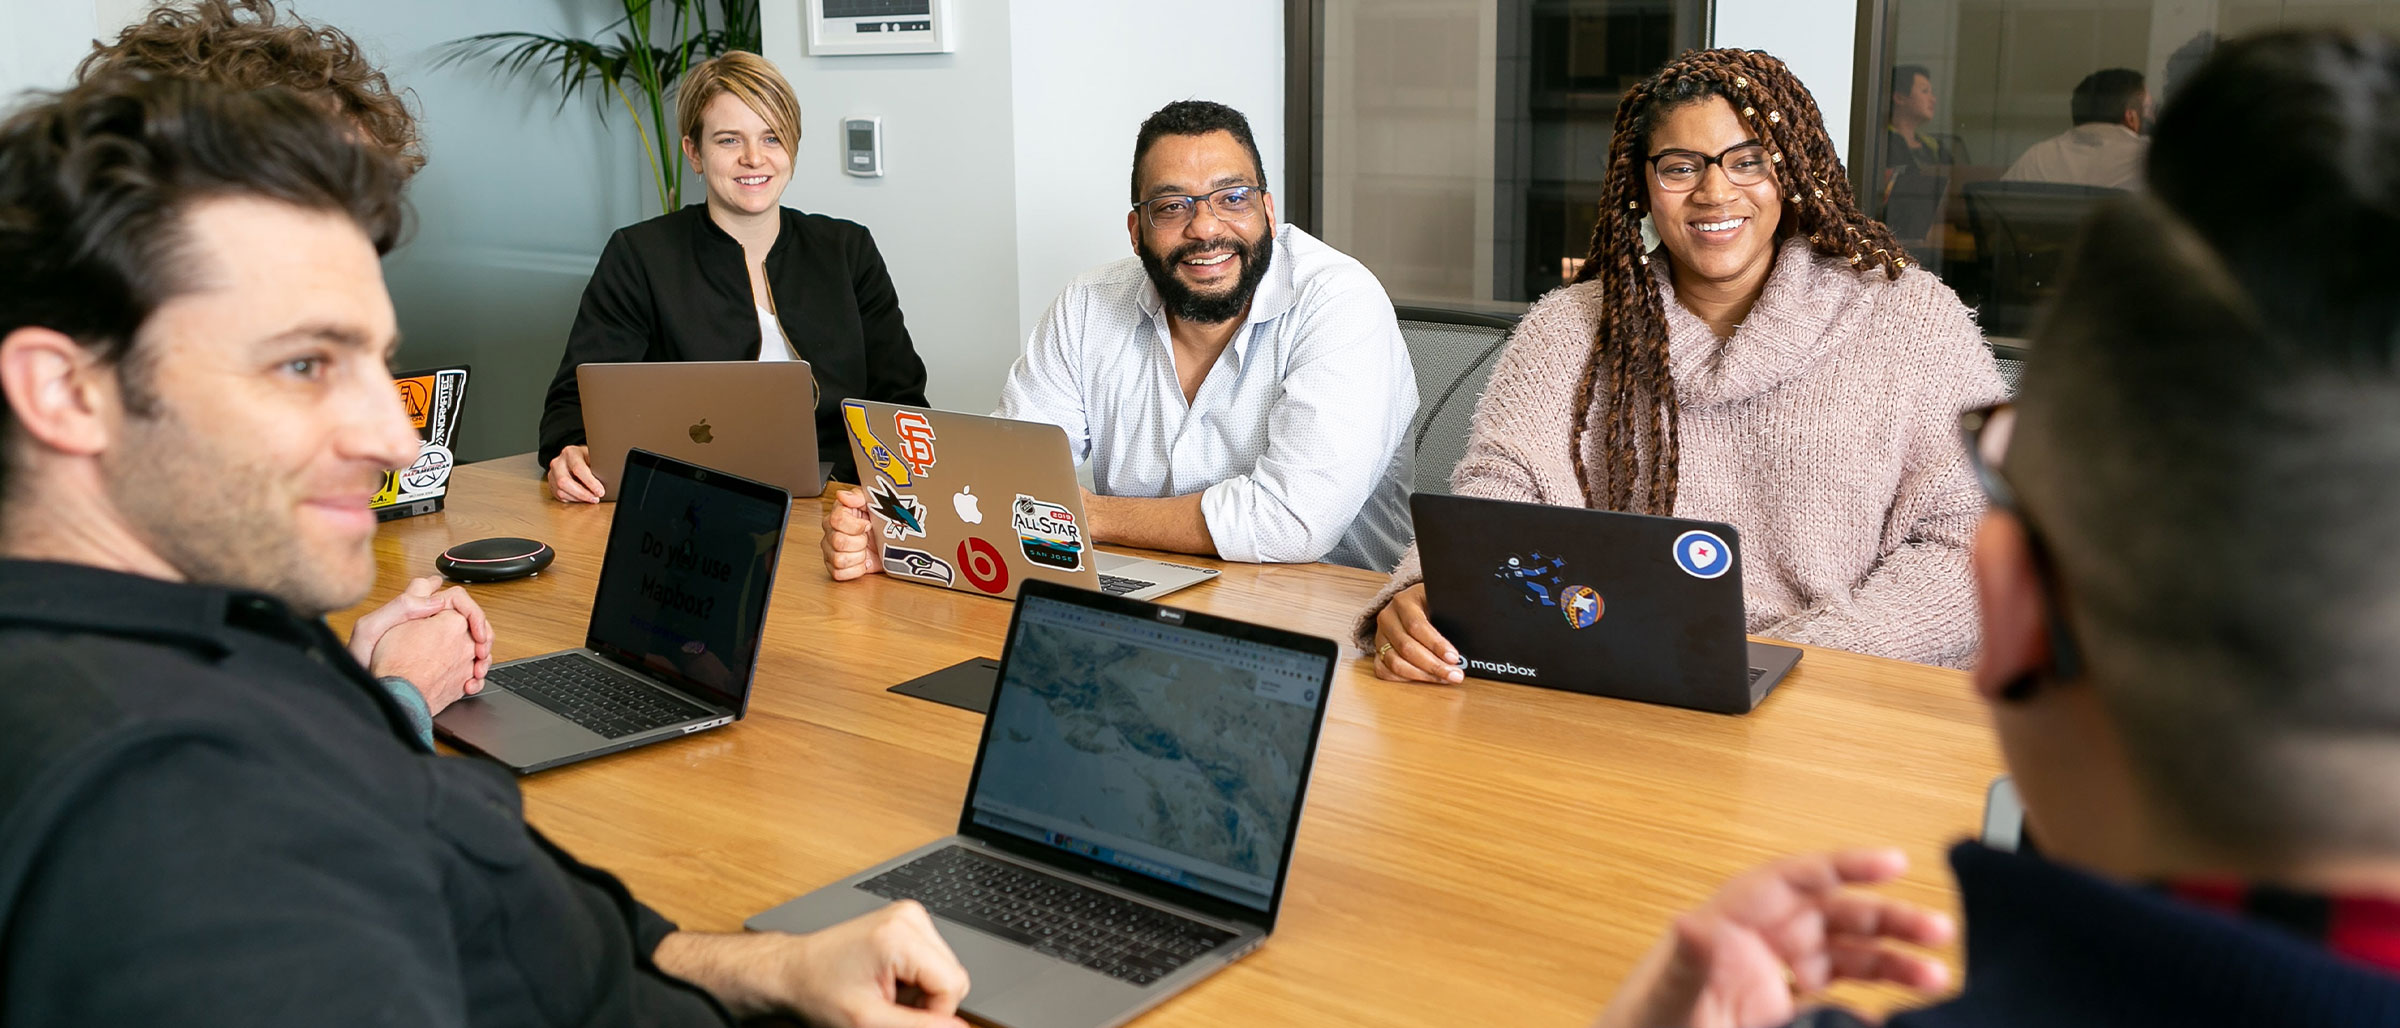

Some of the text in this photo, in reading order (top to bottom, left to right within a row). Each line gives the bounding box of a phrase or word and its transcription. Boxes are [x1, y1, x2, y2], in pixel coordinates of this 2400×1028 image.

[437, 375, 449, 432] NORMATEC
[1052, 512, 1072, 520] 2019
[641, 531, 732, 582] Do you use
[1029, 549, 1073, 562] SAN JOSE
[640, 573, 714, 620] Mapbox?
[1470, 659, 1536, 677] mapbox
